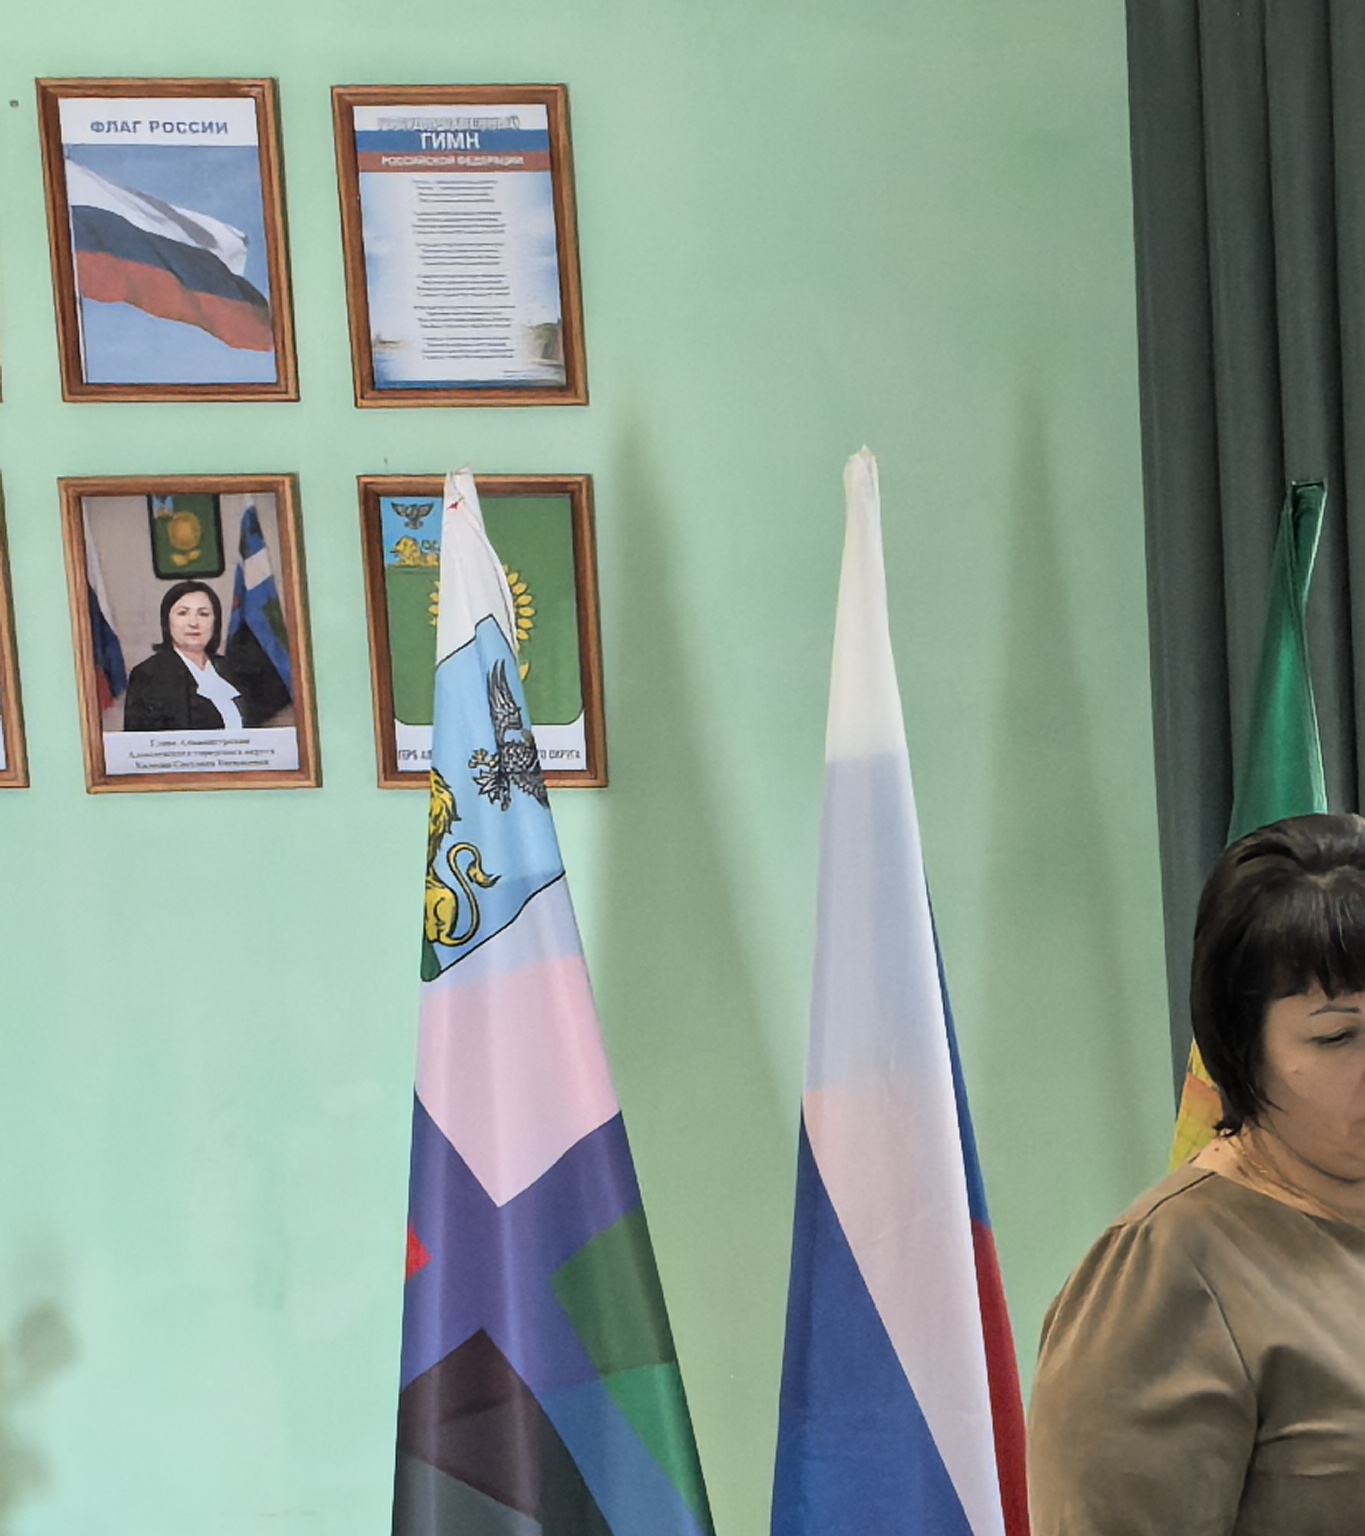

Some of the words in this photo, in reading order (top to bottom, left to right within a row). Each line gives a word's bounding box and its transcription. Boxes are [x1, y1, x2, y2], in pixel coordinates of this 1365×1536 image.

[90, 120, 142, 134] ФЛАГ
[149, 120, 228, 134] РОССИИ
[420, 131, 481, 150] ГИМН
